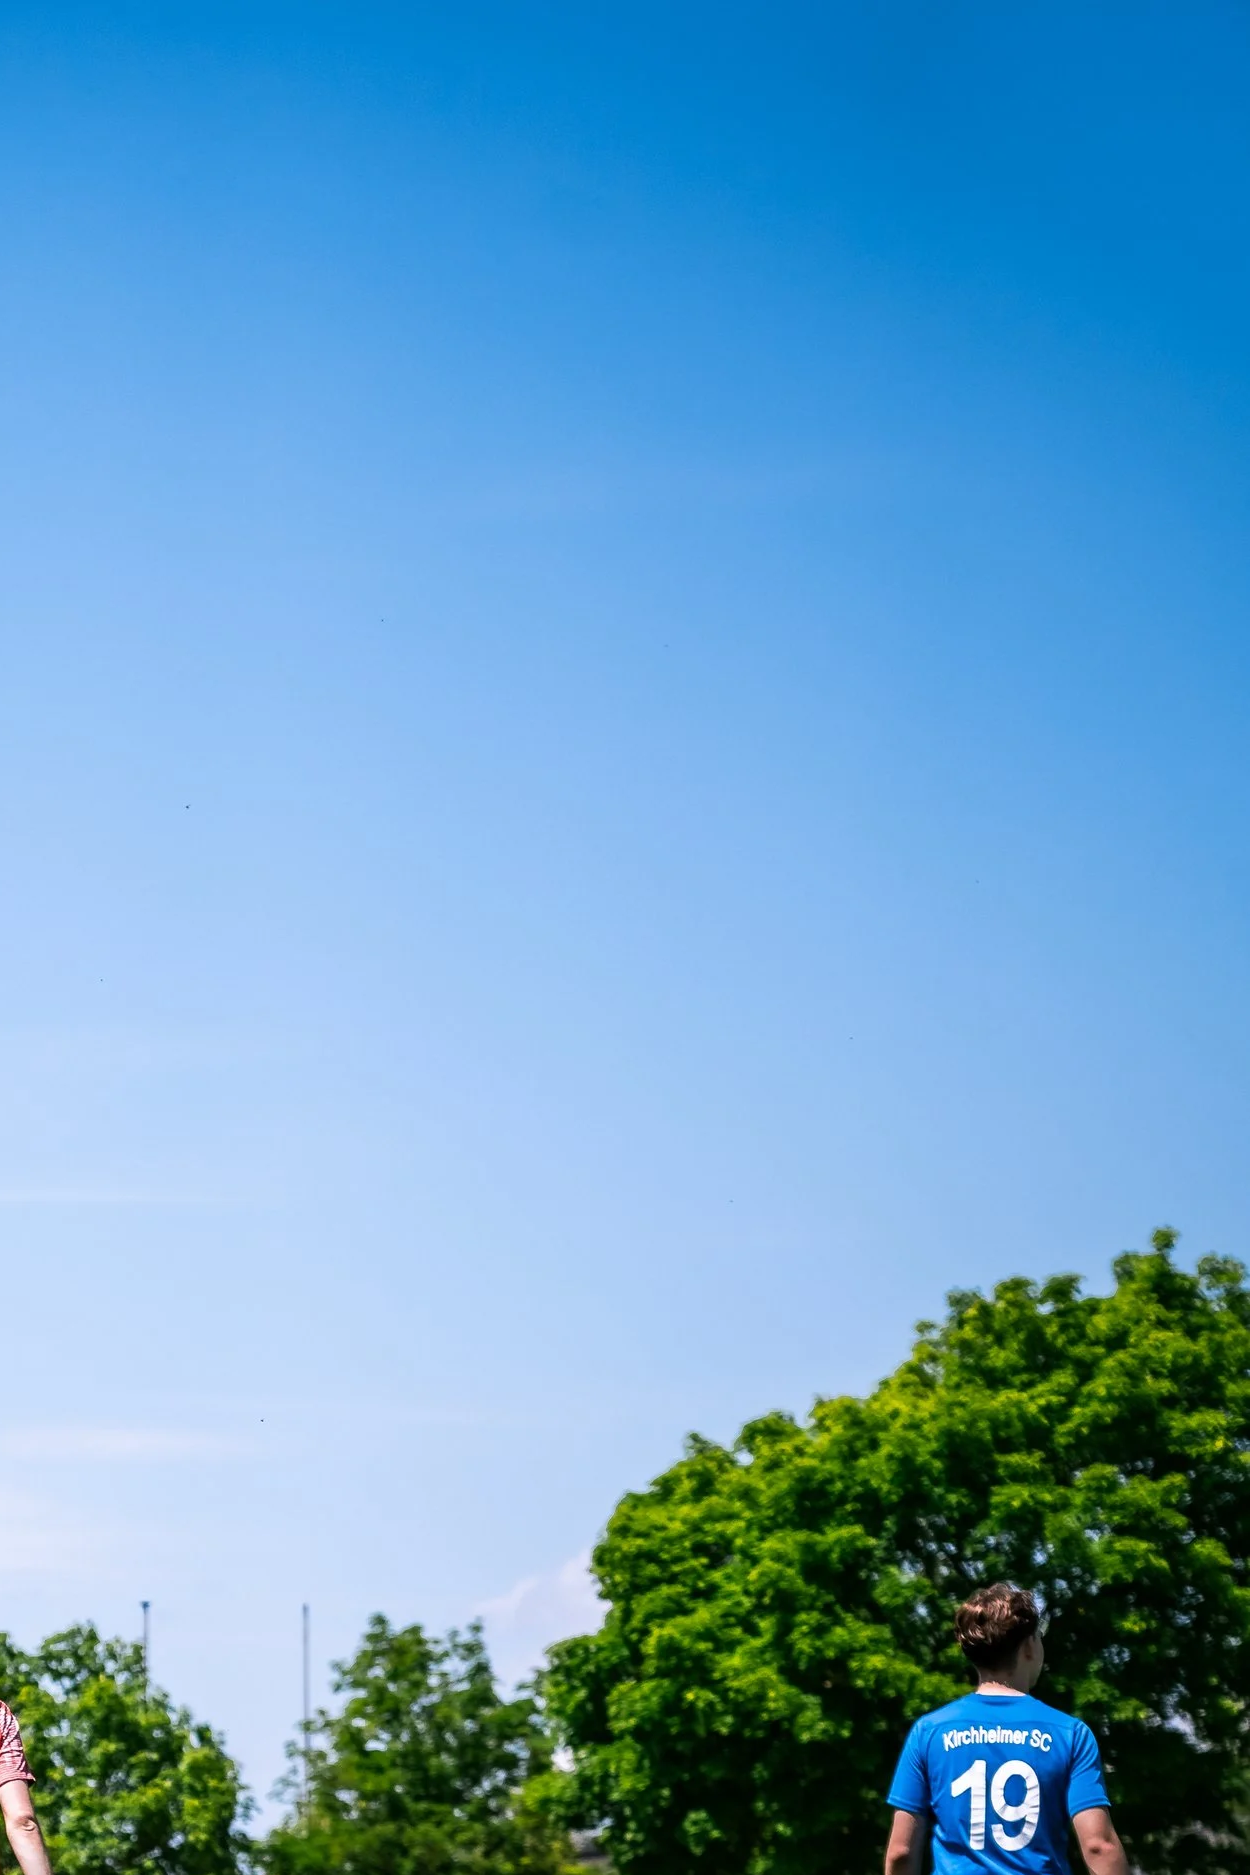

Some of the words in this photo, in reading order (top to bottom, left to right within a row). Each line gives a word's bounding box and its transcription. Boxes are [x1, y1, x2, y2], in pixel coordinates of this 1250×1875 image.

[943, 1726, 1029, 1751] Kirchheimer
[1030, 1729, 1052, 1752] SC
[951, 1760, 1040, 1851] 19
